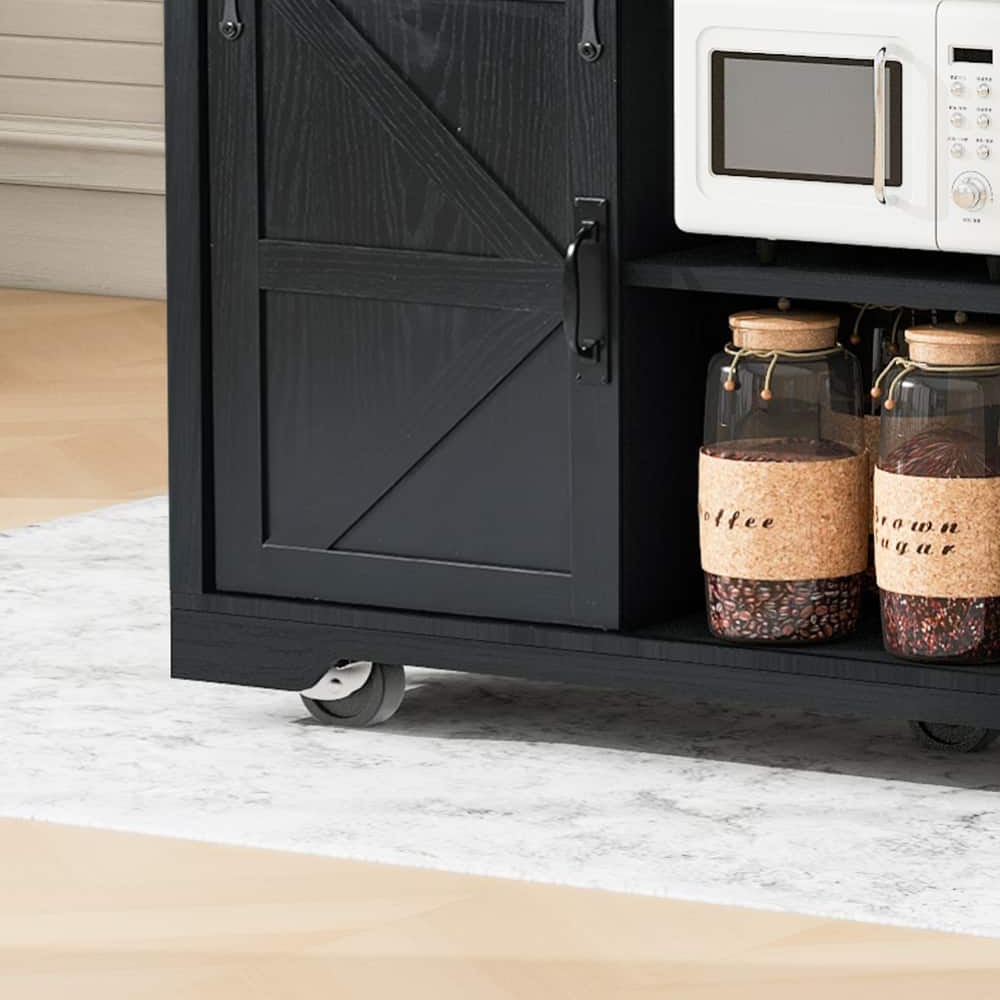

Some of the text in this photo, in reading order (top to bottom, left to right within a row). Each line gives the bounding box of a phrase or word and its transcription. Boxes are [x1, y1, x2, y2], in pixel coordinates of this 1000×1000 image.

[701, 509, 775, 529] offee
[876, 505, 960, 534] rown
[876, 529, 956, 556] ugar
